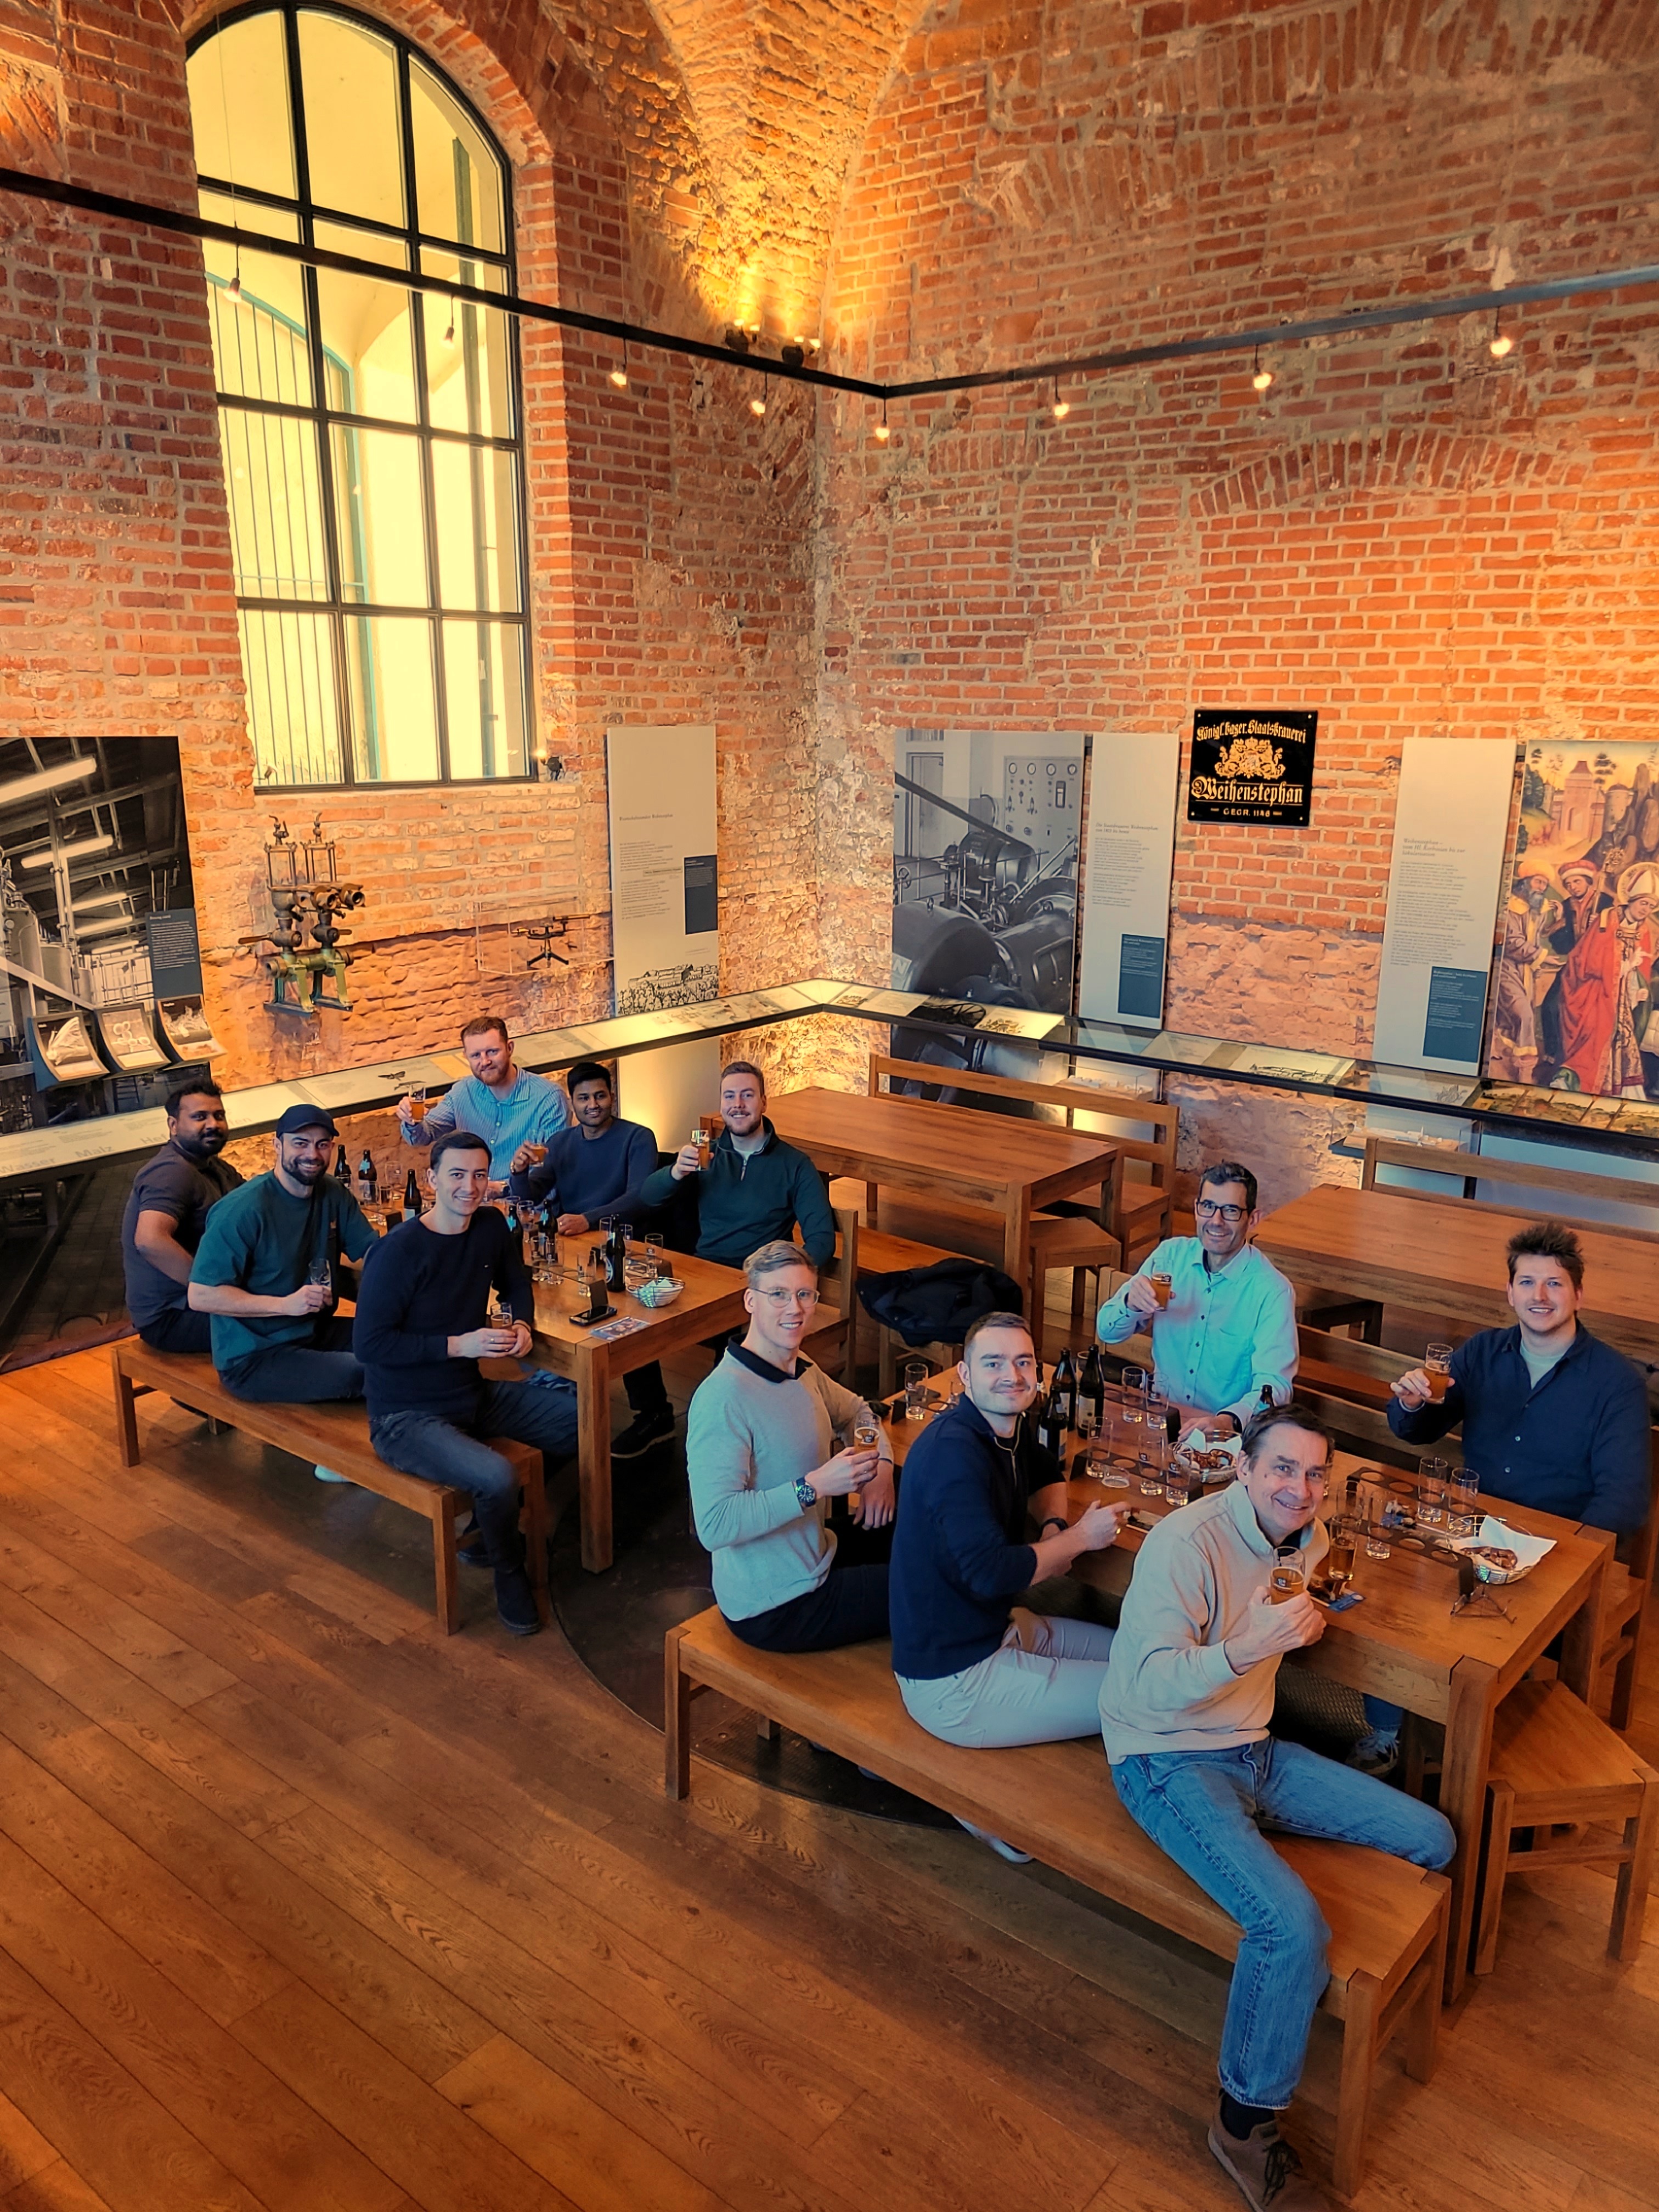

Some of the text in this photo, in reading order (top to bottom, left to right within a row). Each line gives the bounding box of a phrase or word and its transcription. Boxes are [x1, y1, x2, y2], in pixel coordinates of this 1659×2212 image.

[1248, 719, 1306, 744] Staatsbrauerei
[1190, 776, 1303, 807] Weihenstephan
[1223, 808, 1250, 816] GEGR.
